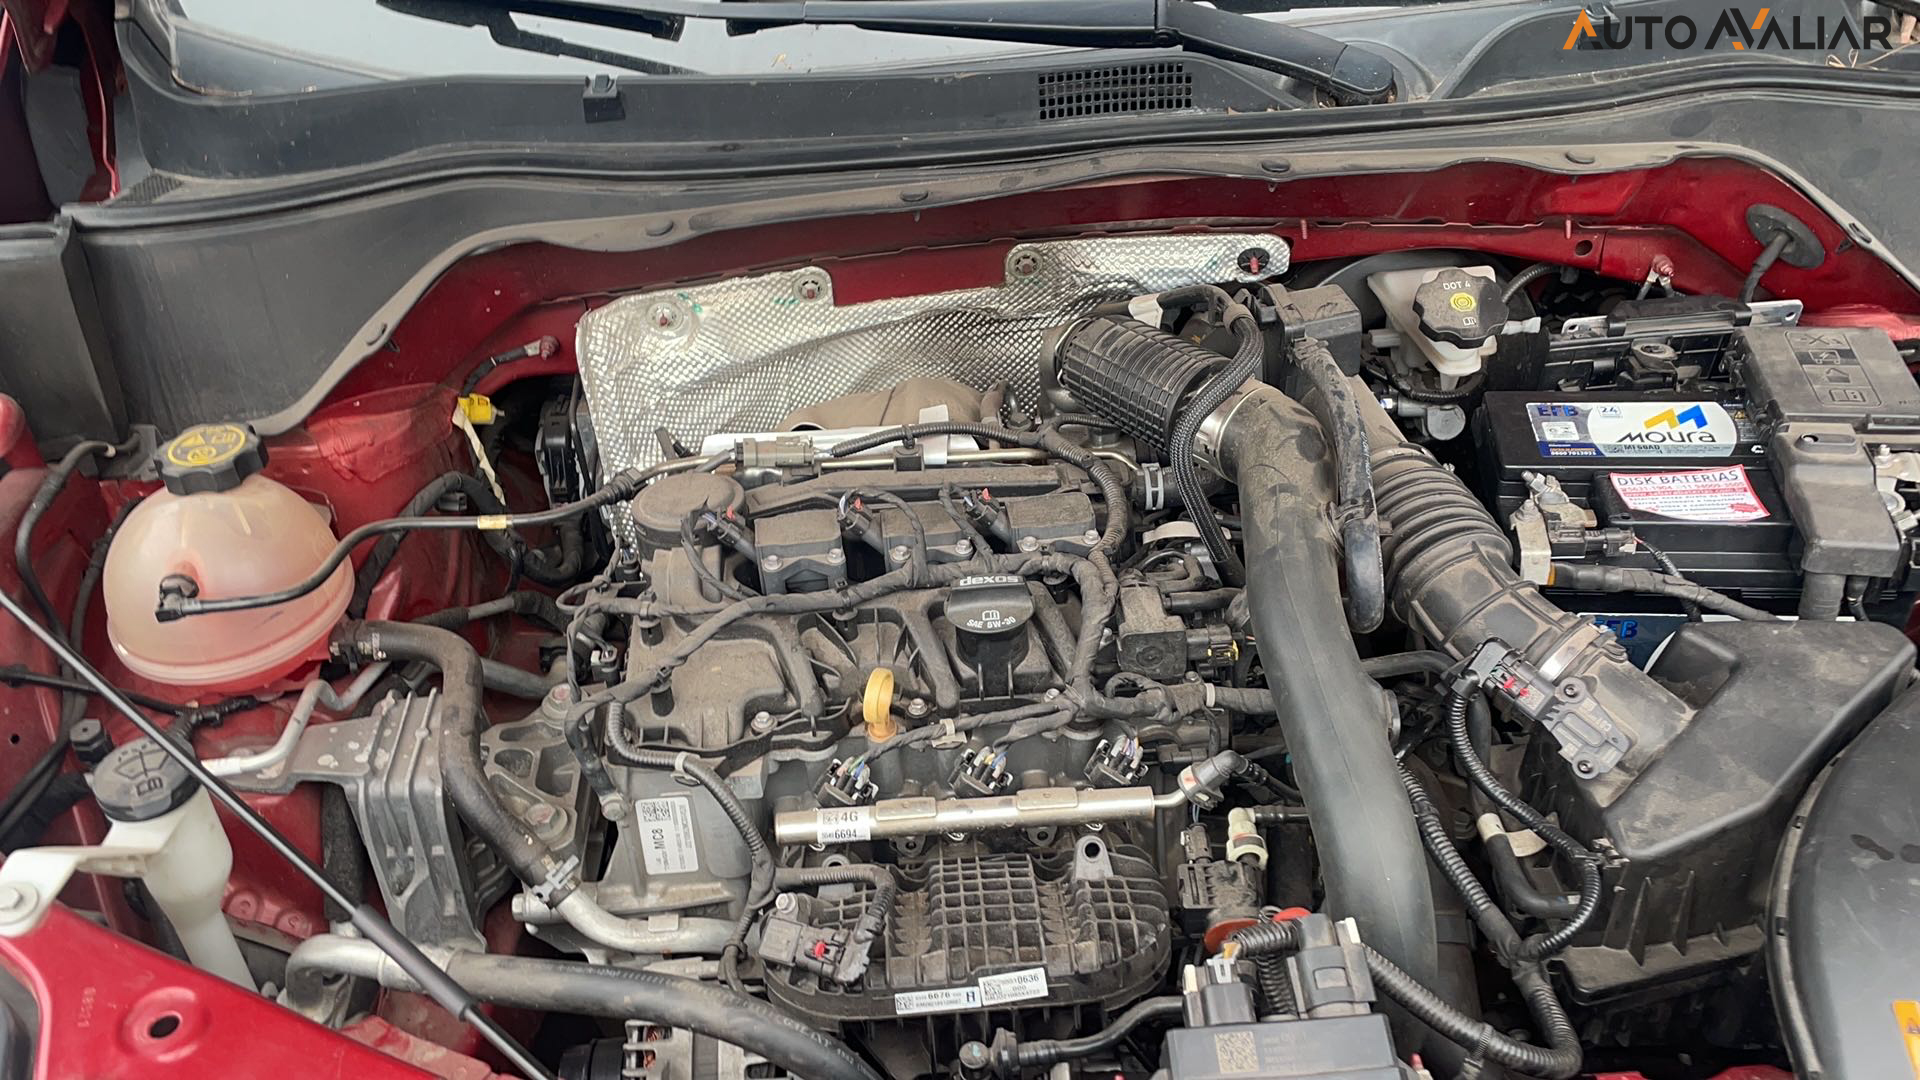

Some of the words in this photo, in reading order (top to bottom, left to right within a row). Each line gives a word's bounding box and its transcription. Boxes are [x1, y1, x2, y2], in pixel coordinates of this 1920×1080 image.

[1443, 281, 1462, 290] DOT
[1465, 280, 1471, 288] 4
[1538, 404, 1579, 417] EFB
[1617, 476, 1657, 486] DISK
[1660, 469, 1739, 485] BATERIAS
[960, 575, 1019, 586] dexos
[966, 619, 983, 629] SAE
[986, 616, 1017, 629] 5W-30
[651, 827, 666, 850] MC8
